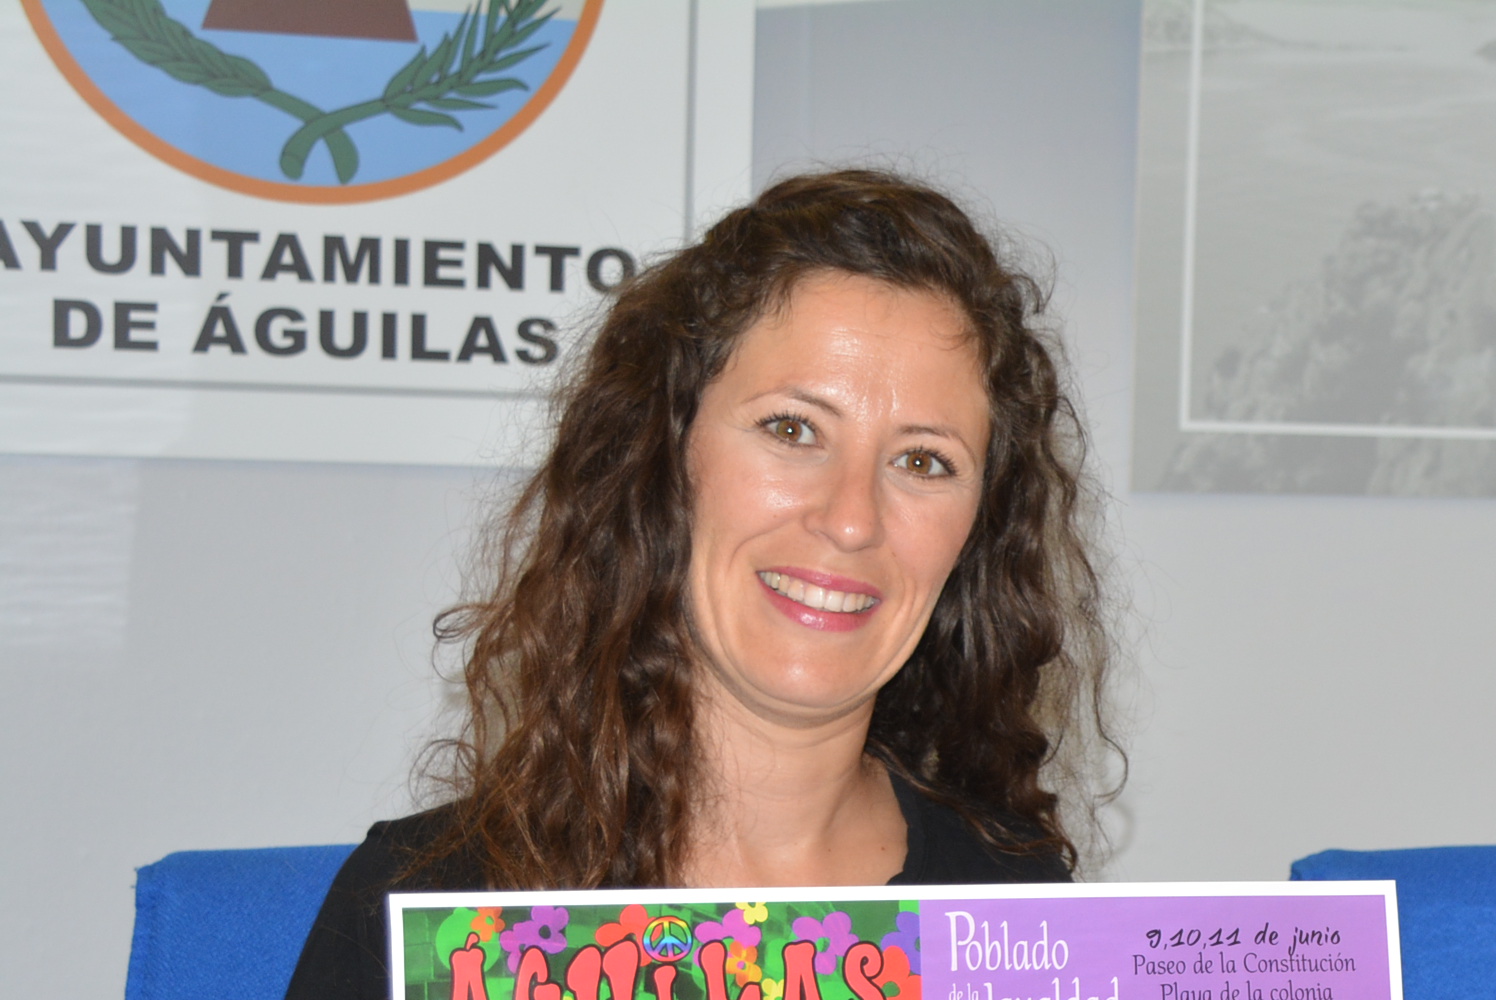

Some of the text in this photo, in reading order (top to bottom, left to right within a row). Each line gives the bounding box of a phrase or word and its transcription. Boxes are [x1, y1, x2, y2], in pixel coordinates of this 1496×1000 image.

[52, 292, 559, 366] DE ÁGUILAS
[945, 911, 1069, 972] Poblado
[1254, 922, 1279, 945] de
[1288, 927, 1341, 955] junio
[1132, 951, 1356, 975] Paseo de la Constitución
